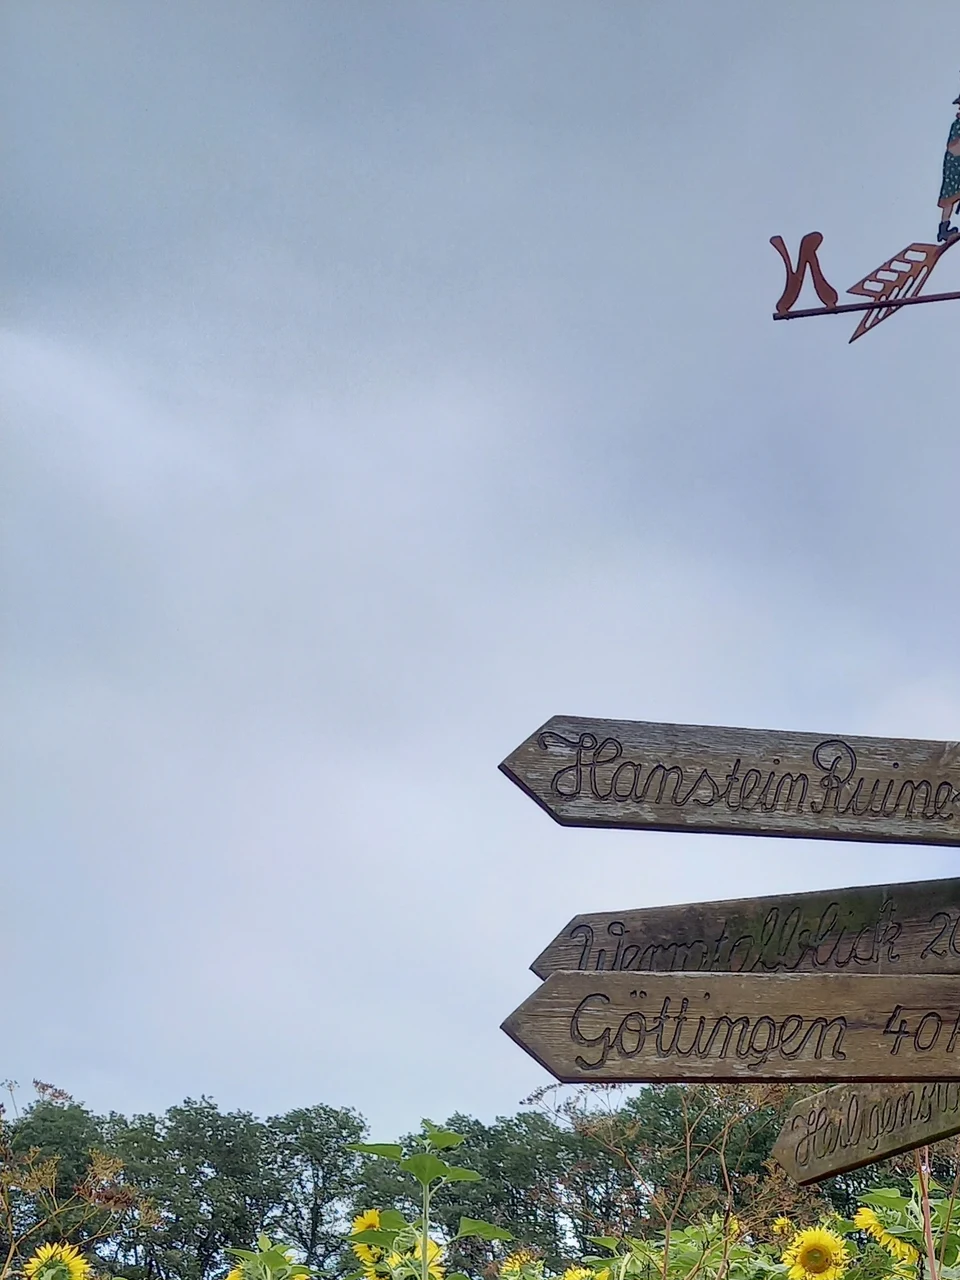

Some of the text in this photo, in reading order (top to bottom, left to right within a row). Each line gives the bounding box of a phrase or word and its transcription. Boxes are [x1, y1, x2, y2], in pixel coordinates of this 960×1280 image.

[537, 731, 808, 813] Hanstein
[811, 739, 953, 820] Ruine
[570, 991, 846, 1070] Göttingen
